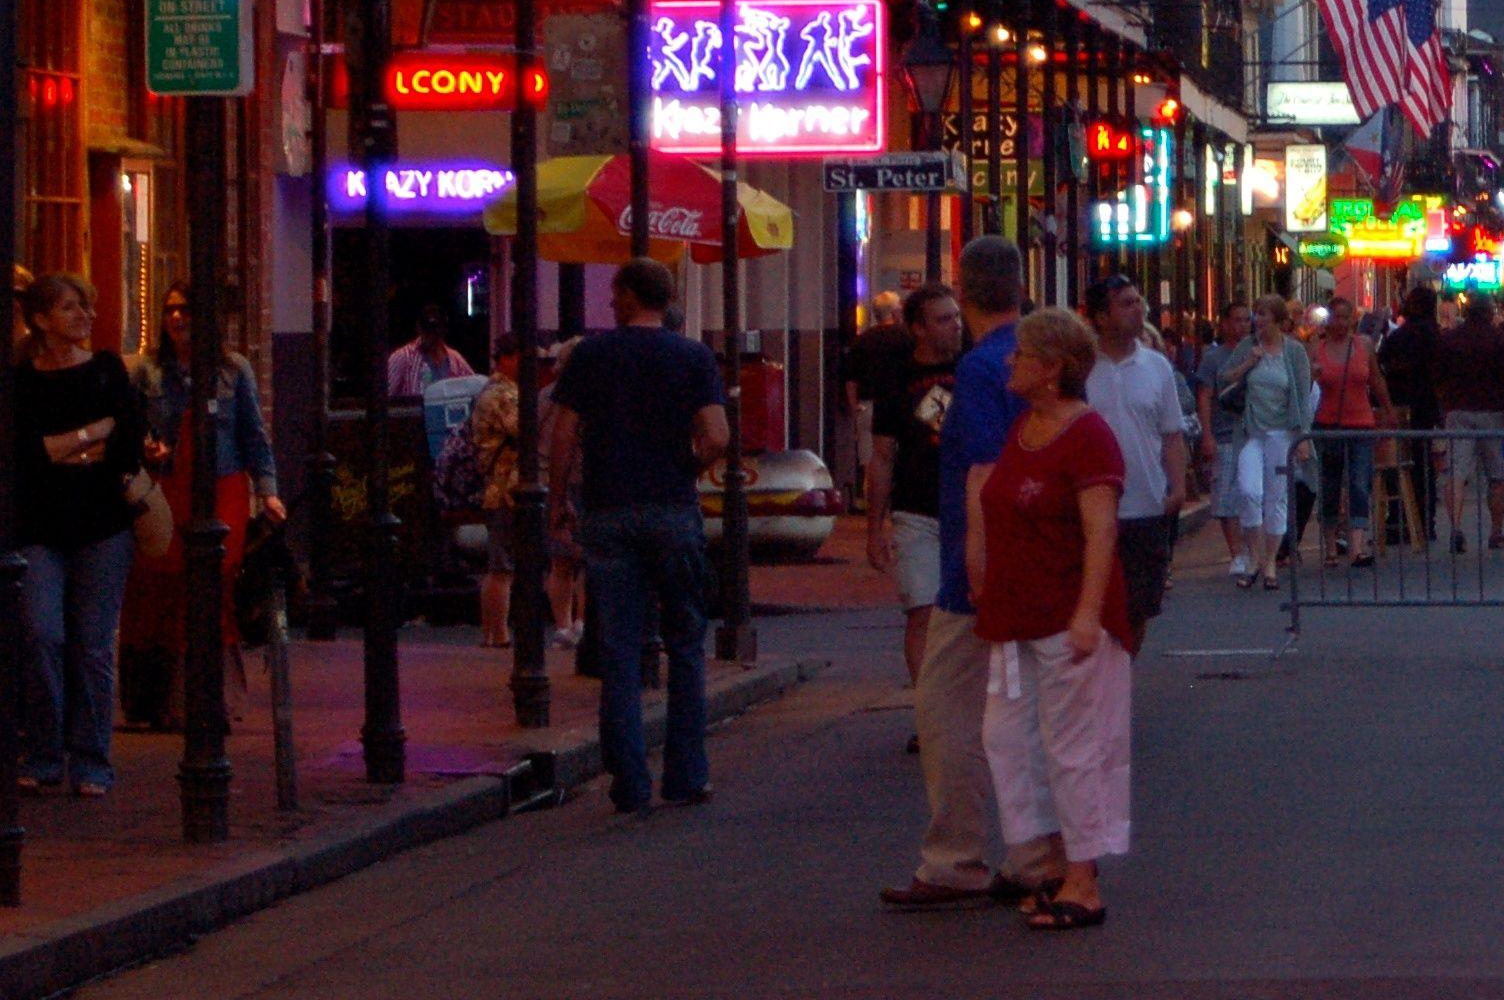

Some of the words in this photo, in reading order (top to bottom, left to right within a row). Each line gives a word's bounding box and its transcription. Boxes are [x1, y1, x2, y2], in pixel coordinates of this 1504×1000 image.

[396, 69, 504, 94] LCONY
[654, 97, 742, 140] Kraz
[749, 102, 869, 142] Korner
[347, 170, 433, 198] KAZY
[831, 168, 866, 188] St.
[877, 168, 939, 187] Peter
